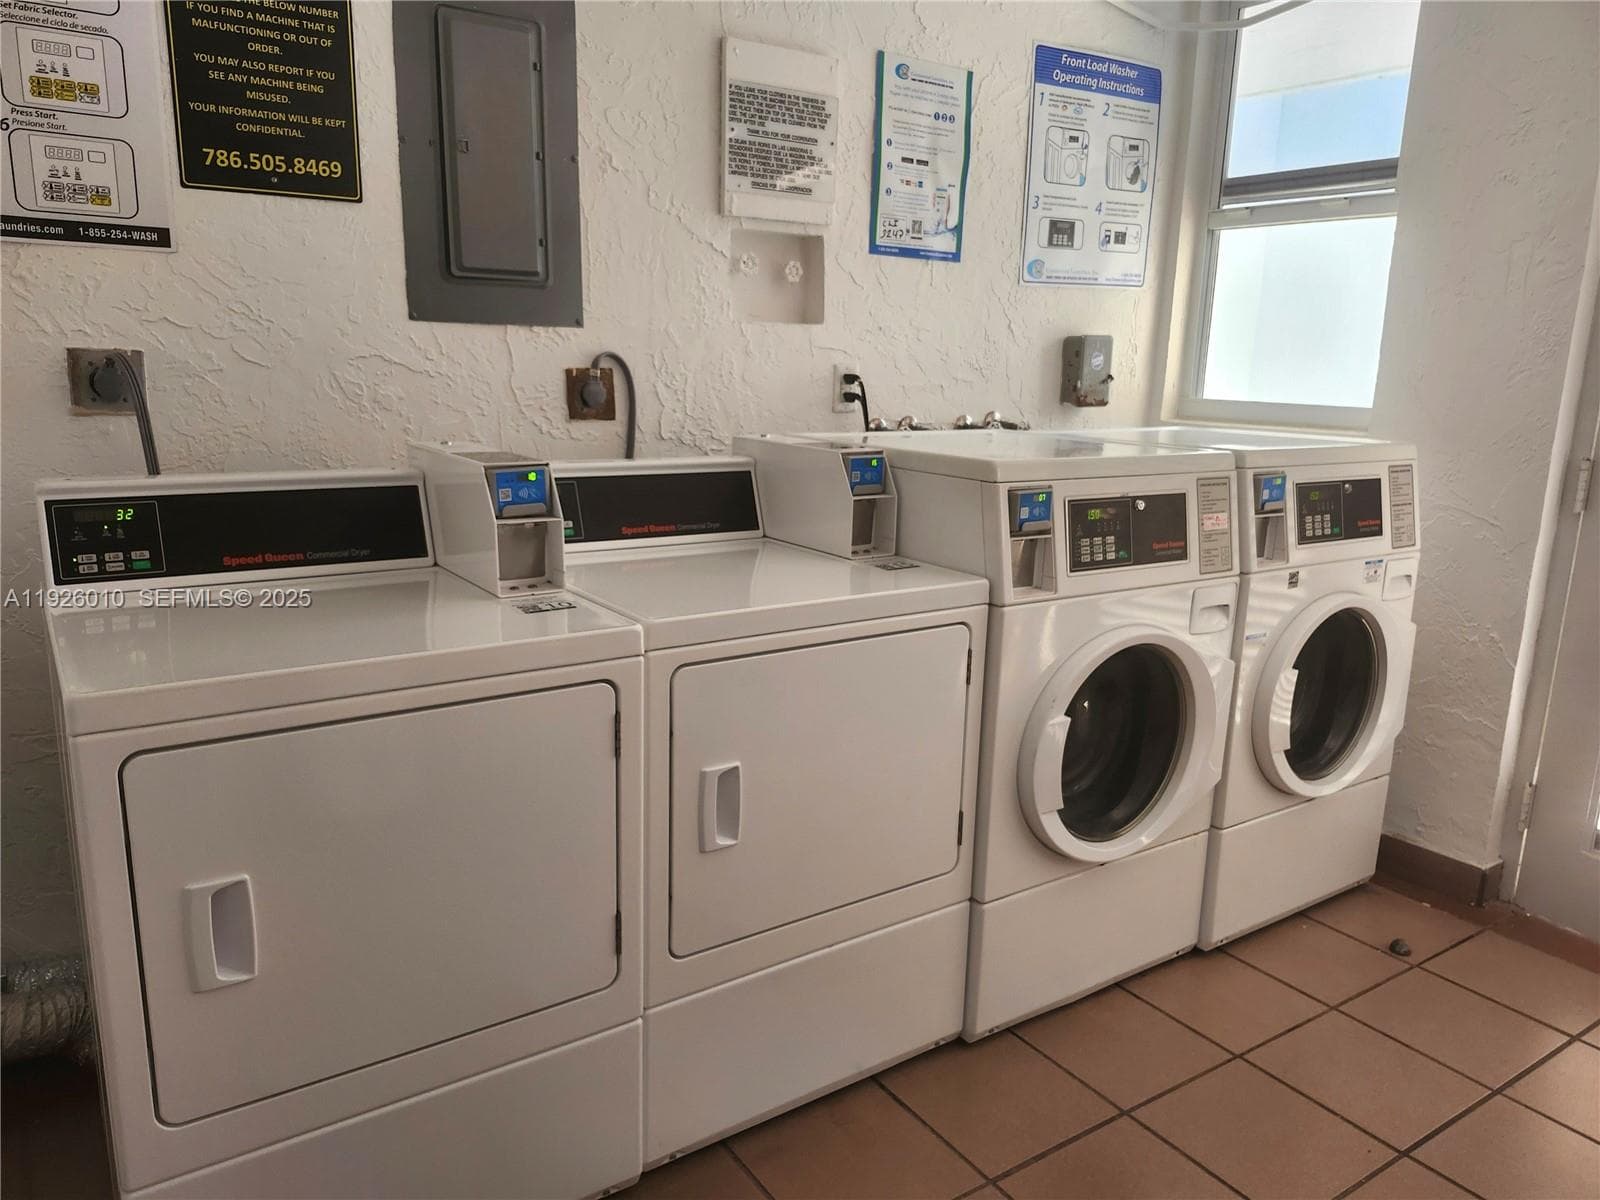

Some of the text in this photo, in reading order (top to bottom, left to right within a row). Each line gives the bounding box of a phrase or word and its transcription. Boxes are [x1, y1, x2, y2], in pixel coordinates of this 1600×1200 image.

[13, 3, 40, 13] Fabric
[42, 7, 78, 19] Selector.
[186, 1, 336, 33] IF YOU FIND A MACHINE THAT IS
[264, 0, 296, 12] BELOW
[299, 5, 339, 19] NUMBER
[50, 18, 68, 28] ciclo
[80, 25, 109, 34] secado.
[191, 18, 333, 48] MALFUNCTIONING OR OUT OF
[247, 42, 283, 55] ORDER.
[193, 52, 336, 80] YOU MAY ALSO REPORT IF YOU
[1062, 54, 1138, 78] Front Load Washer
[208, 70, 324, 93] SEE ANY MACHINE BEING
[1053, 70, 1144, 96] Operating Instructions
[246, 90, 291, 104] MISUSED.
[1040, 92, 1044, 106] 1
[10, 107, 58, 120] Press Start.
[188, 101, 346, 128] YOUR INFORMATION WILL BE KEPT
[1102, 102, 1110, 116] 2
[0, 118, 10, 131] 6
[12, 118, 67, 130] Presione Start.
[236, 122, 305, 138] CONFIDENTIAL.
[202, 148, 342, 178] 786.505.8469
[1032, 196, 1040, 210] 3
[1095, 202, 1102, 215] 4
[79, 227, 158, 241] 1-855-254-WASH
[117, 509, 133, 520] 32
[621, 524, 649, 535] Speed
[650, 524, 676, 532] Queen
[223, 554, 262, 567] Speed
[264, 552, 304, 562] Queen
[306, 550, 349, 560] Commercial
